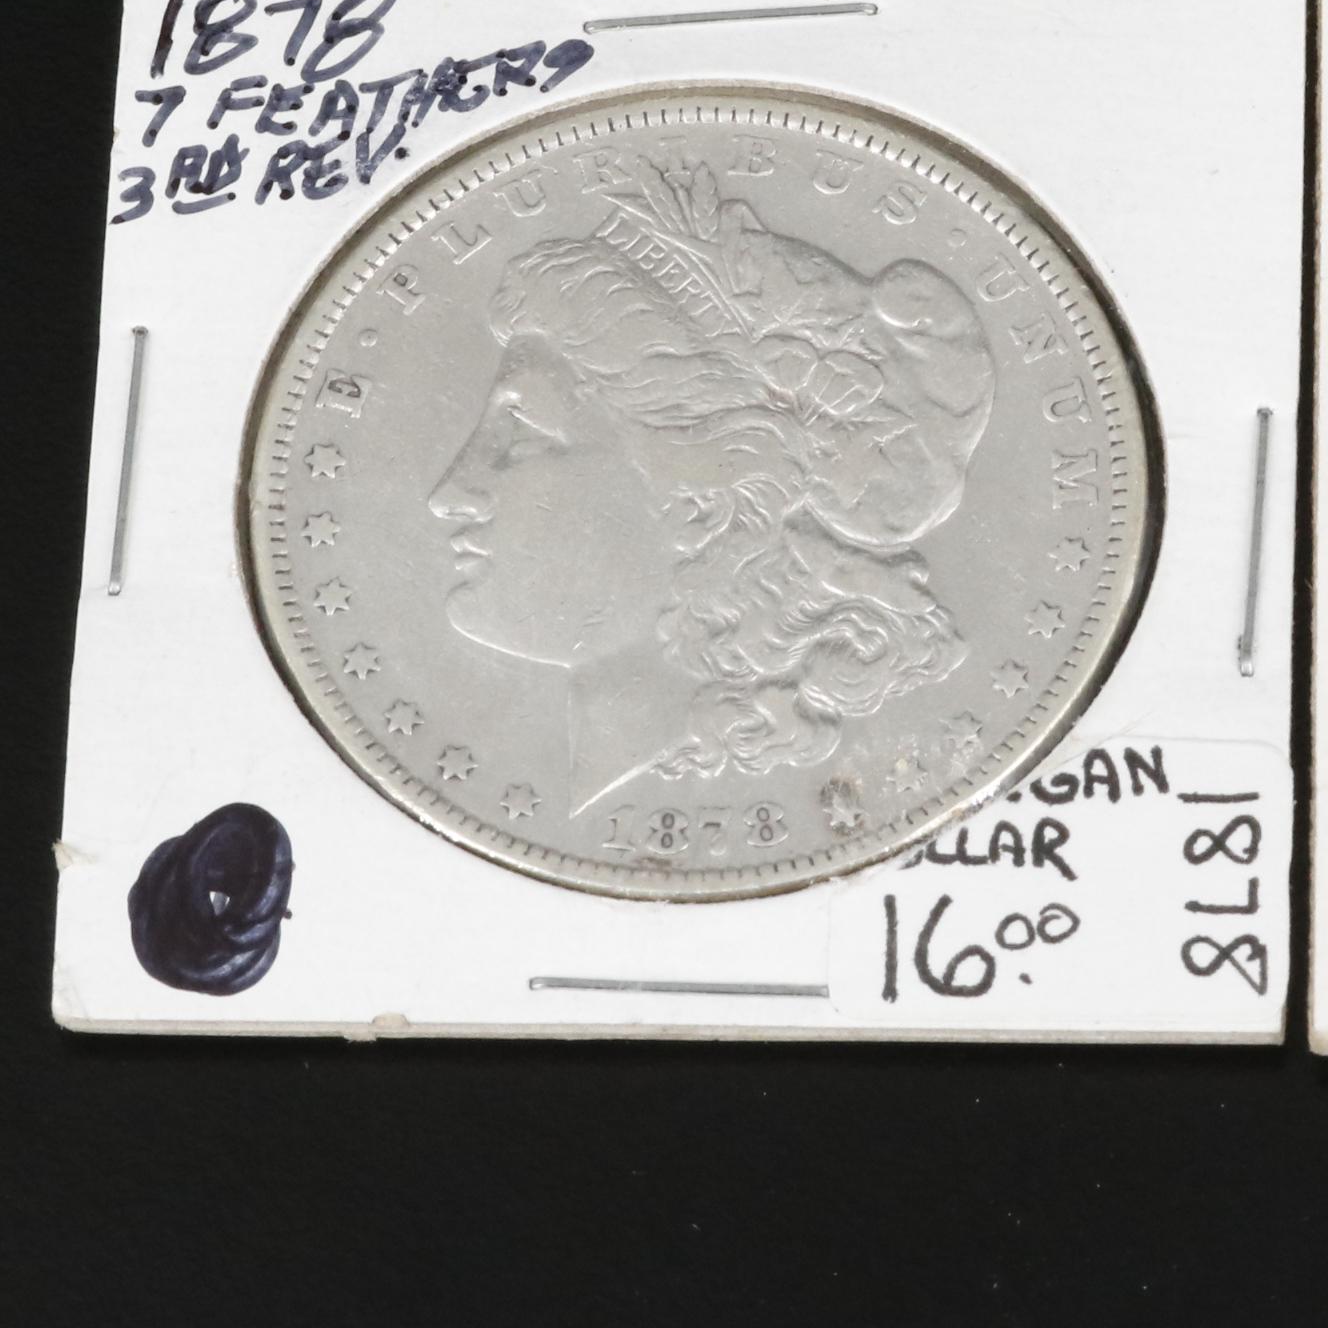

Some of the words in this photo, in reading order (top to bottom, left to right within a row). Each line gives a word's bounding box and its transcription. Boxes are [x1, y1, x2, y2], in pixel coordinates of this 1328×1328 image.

[135, 85, 187, 147] 7
[255, 122, 411, 205] REV.
[317, 369, 372, 419] E
[376, 134, 928, 315] PLURIBUS
[975, 269, 1101, 511] UNUM
[602, 801, 790, 856] 1878
[1177, 791, 1268, 997] 1878
